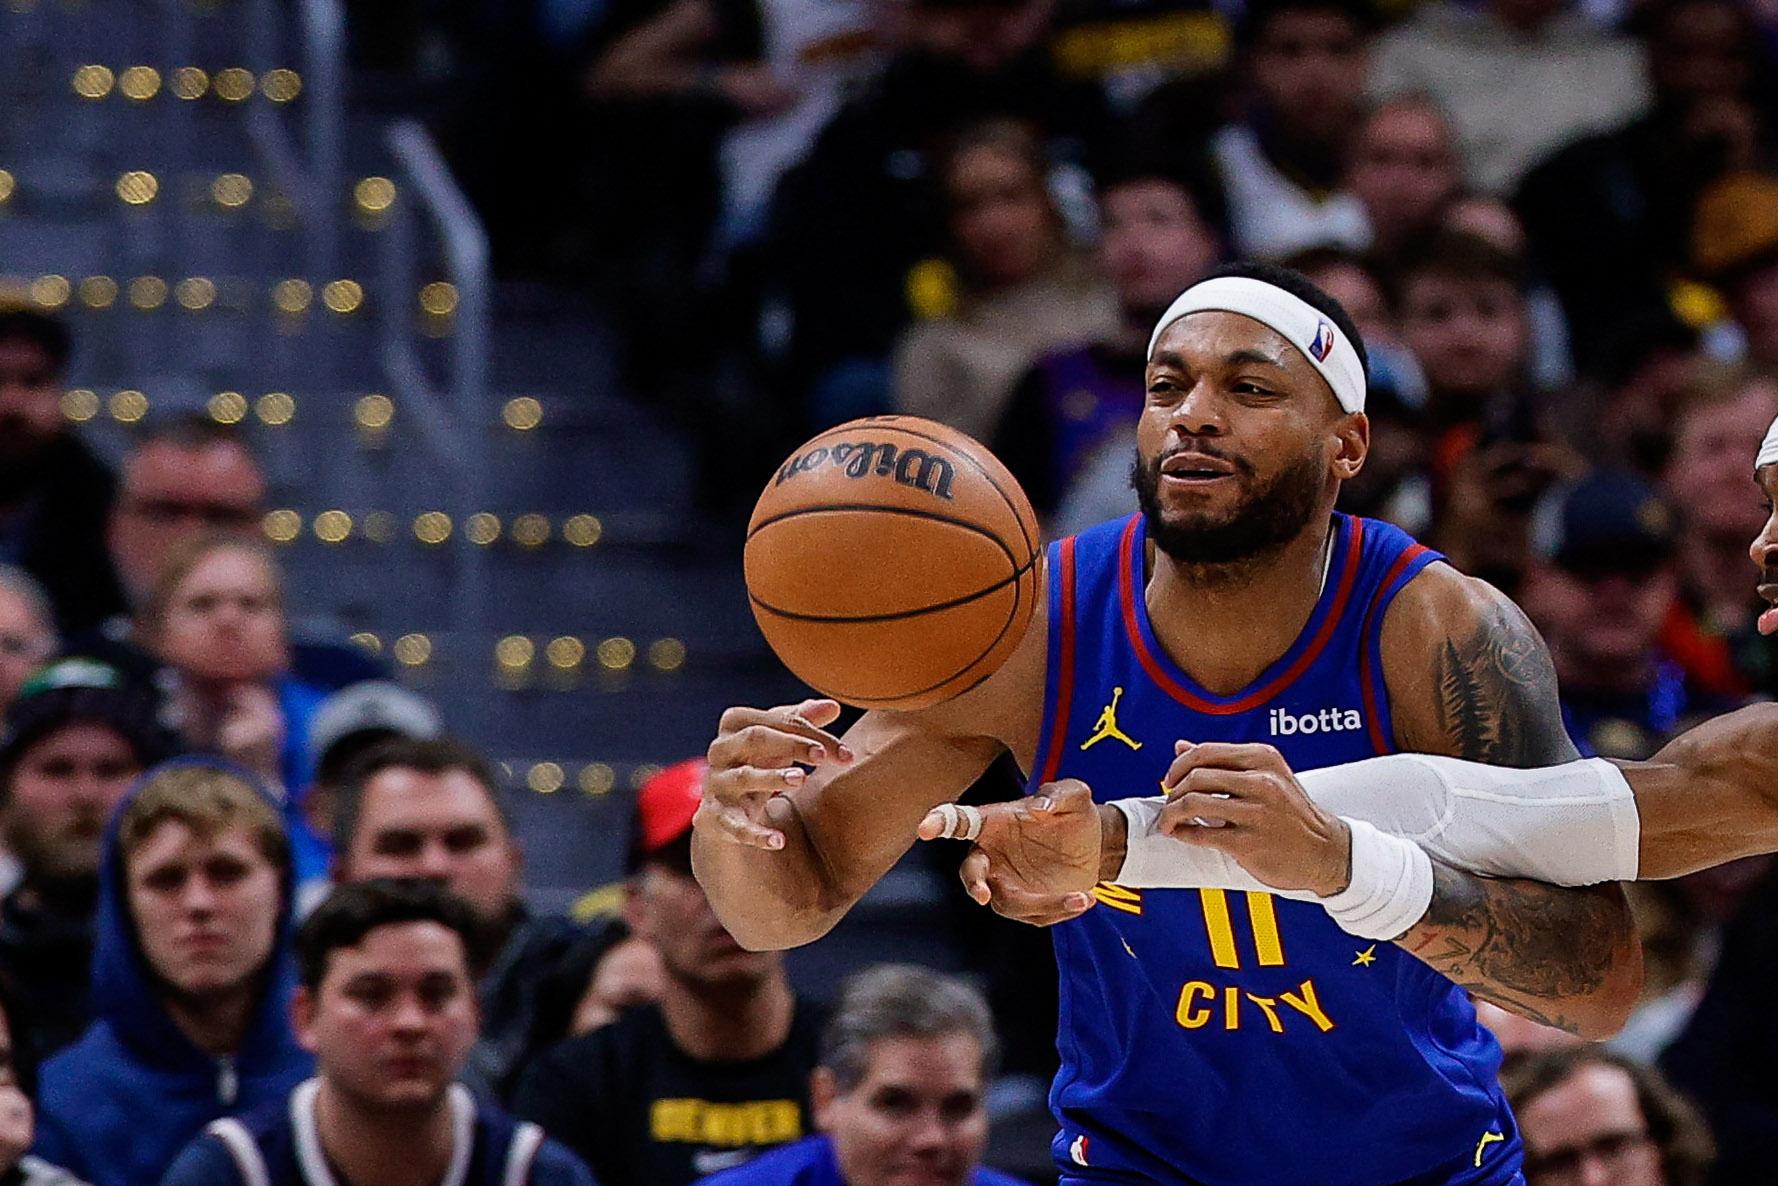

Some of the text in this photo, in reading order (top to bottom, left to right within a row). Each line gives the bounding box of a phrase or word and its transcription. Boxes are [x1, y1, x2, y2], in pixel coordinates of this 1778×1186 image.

[775, 442, 957, 500] Wilson
[1269, 707, 1362, 736] ibotta
[1174, 978, 1335, 1034] CITY
